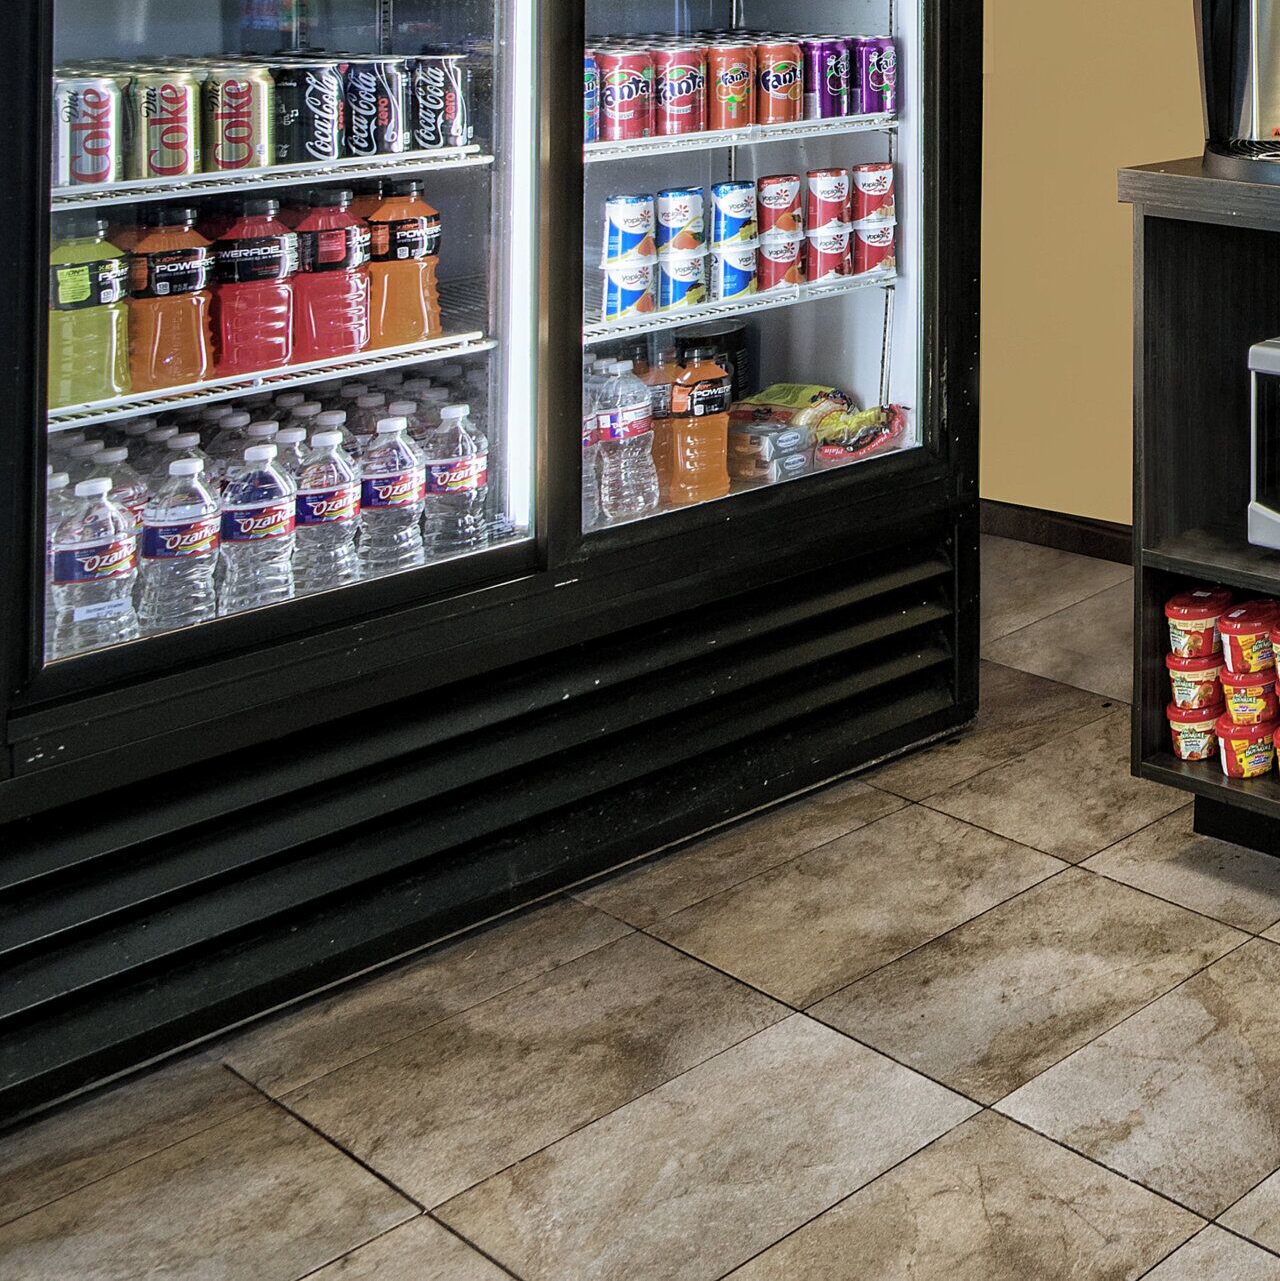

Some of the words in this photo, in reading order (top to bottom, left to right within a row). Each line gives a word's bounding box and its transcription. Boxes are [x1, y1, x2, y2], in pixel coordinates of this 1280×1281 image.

[446, 91, 455, 122] zero
[761, 67, 801, 92] Fanta
[71, 87, 111, 183] Coke
[148, 84, 189, 176] Coke
